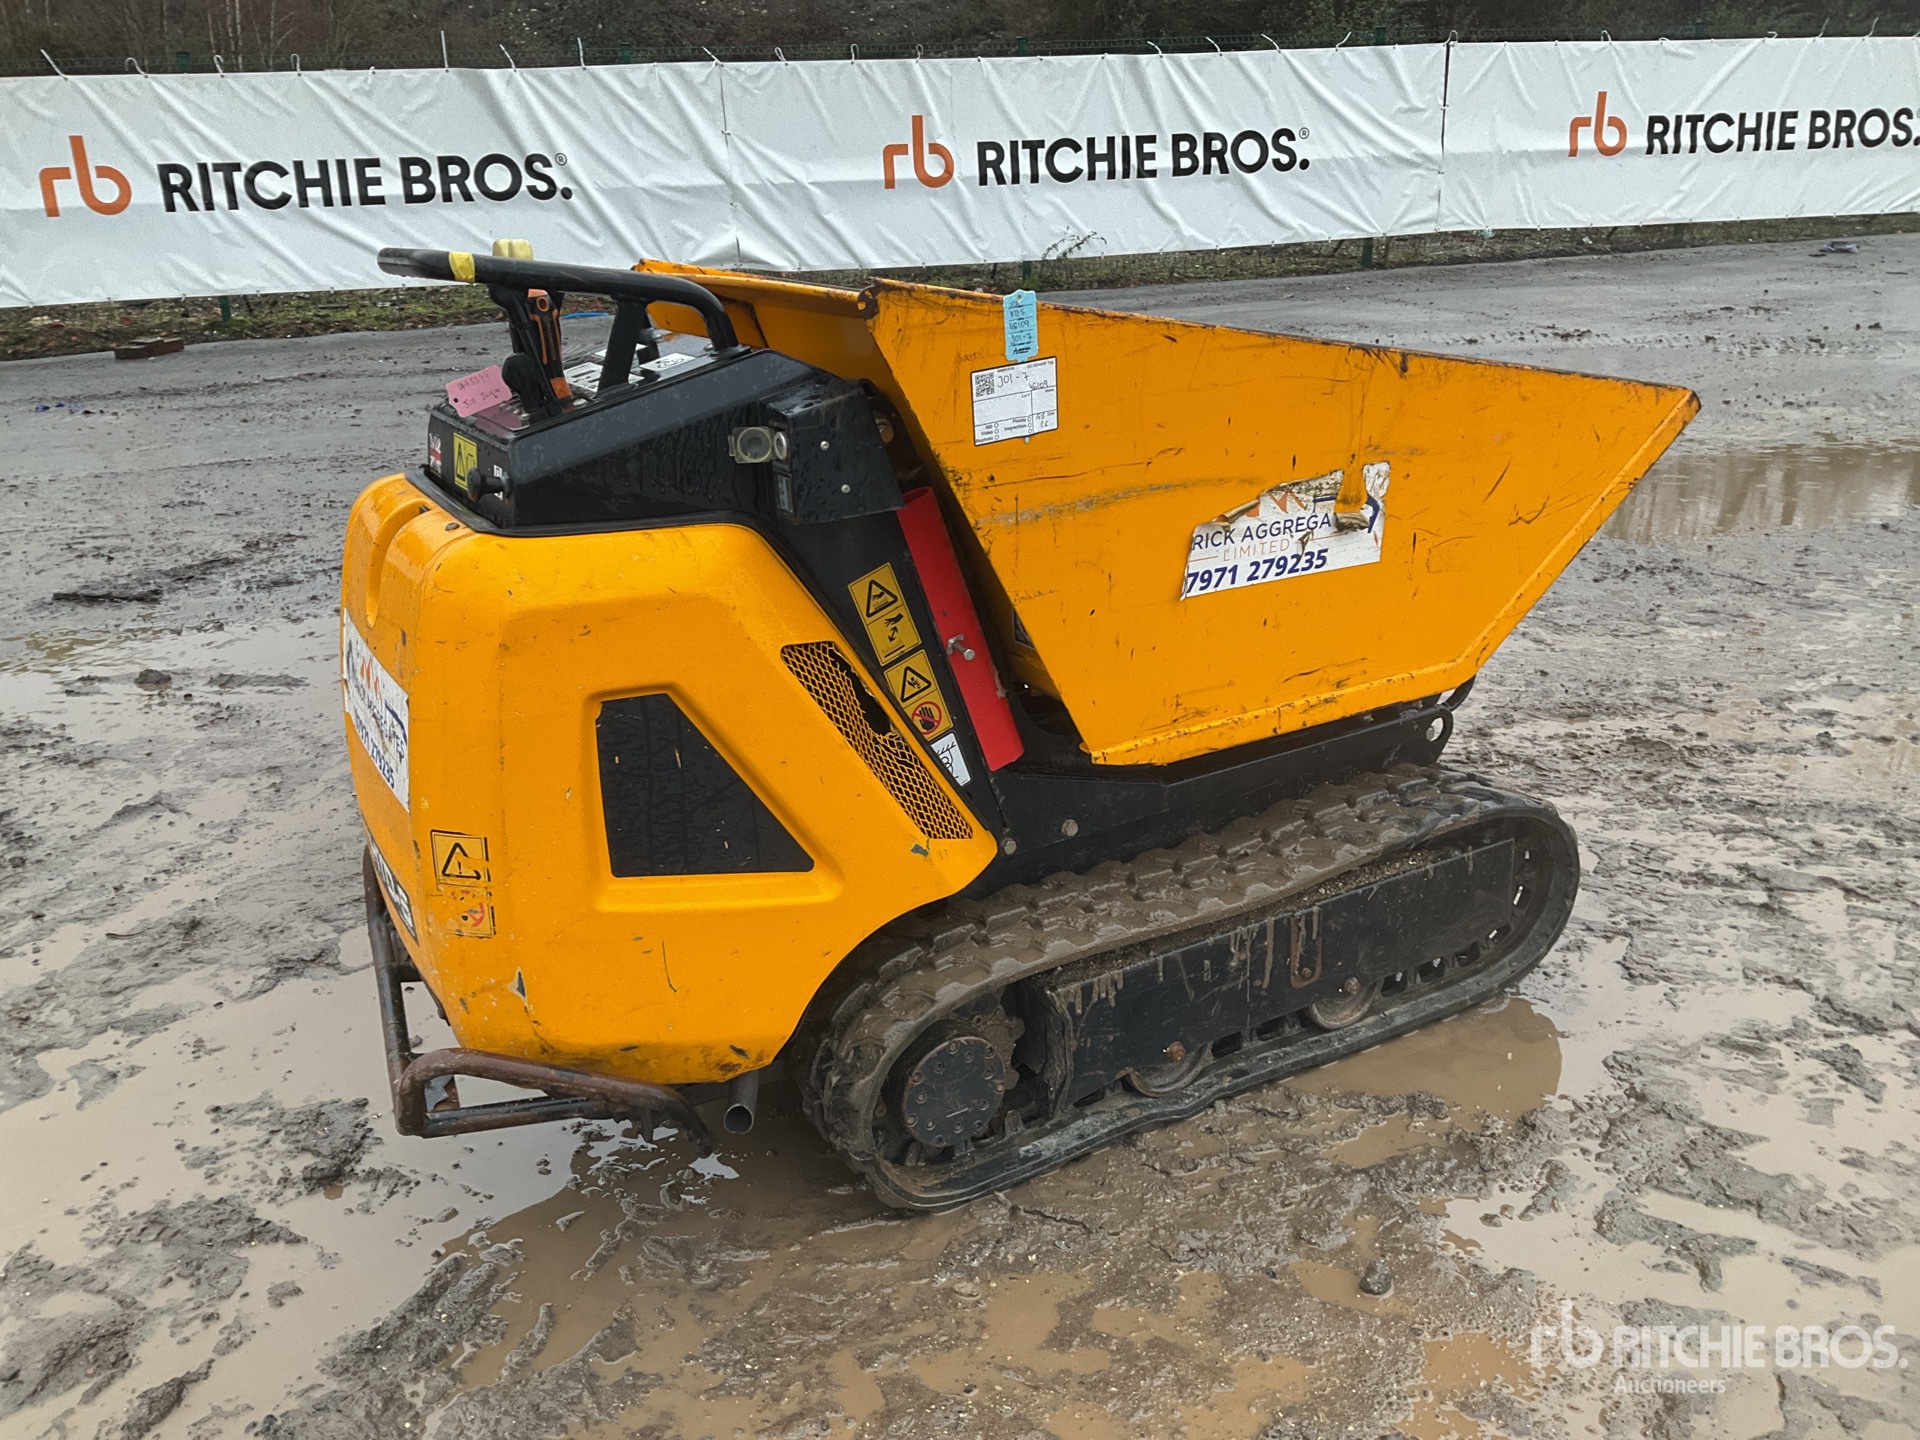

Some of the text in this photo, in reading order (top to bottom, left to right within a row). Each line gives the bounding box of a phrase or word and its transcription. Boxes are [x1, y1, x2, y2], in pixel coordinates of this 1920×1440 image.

[1645, 110, 1799, 155] RITCHIE
[1807, 106, 1920, 150] BROS.
[976, 133, 1157, 187] RITCHIE
[1171, 127, 1310, 177] BROS.
[156, 157, 386, 214] RITCHIE
[398, 151, 573, 205] BROS.
[1223, 538, 1290, 562] LIMITED
[1241, 512, 1332, 542] AGGREGA
[1186, 548, 1329, 594] 7971 279235
